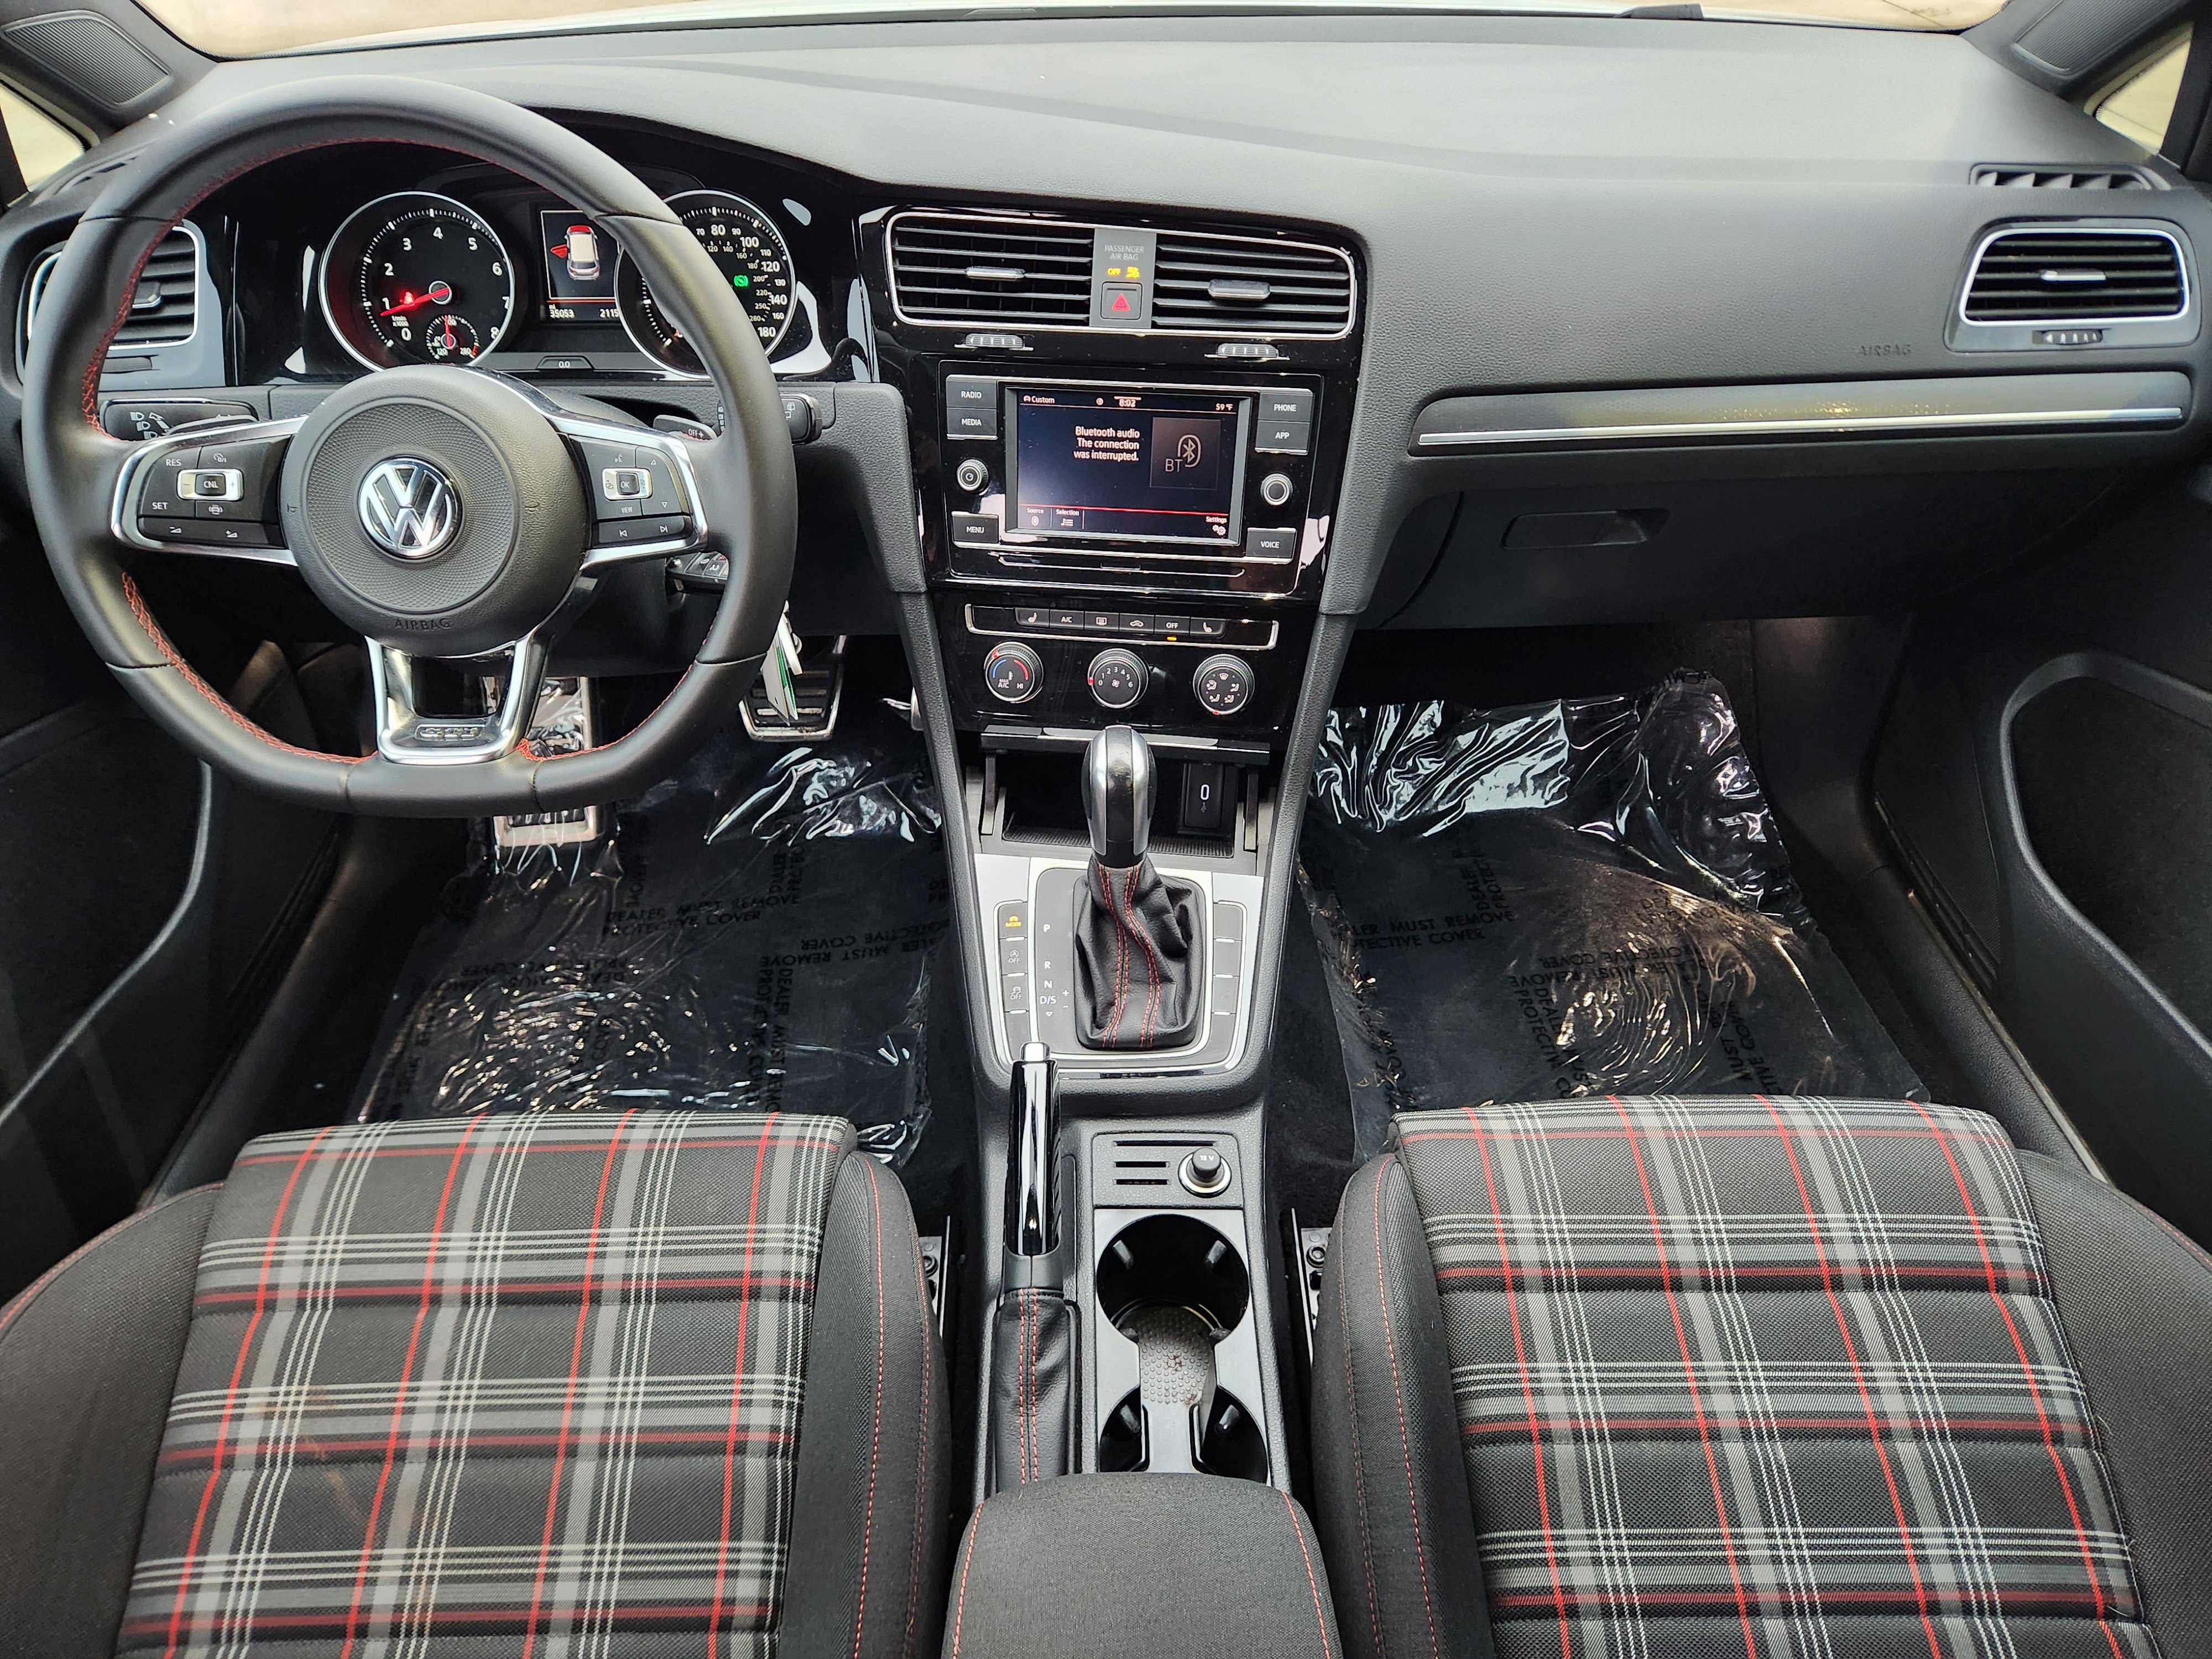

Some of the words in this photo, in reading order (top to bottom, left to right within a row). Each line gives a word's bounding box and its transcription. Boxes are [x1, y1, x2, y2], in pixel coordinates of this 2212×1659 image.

[433, 227, 443, 239] 4
[696, 228, 705, 236] 70
[711, 224, 726, 236] 80
[403, 238, 411, 250] 3
[468, 237, 478, 250] 5
[739, 236, 759, 248] 100
[1105, 244, 1144, 253] PASSENGER
[384, 263, 394, 276] 2
[492, 262, 502, 275] 6
[763, 261, 780, 272] 120
[382, 298, 390, 310] 1
[769, 294, 787, 305] 140
[550, 309, 575, 319] 35053
[401, 327, 412, 341] 0
[491, 327, 499, 339] 8
[758, 327, 776, 337] 180
[961, 390, 982, 399] RADIO
[1031, 395, 1055, 404] Custom
[1119, 399, 1136, 408] 8:02
[1274, 404, 1297, 412] PHONE
[961, 418, 982, 426] MEDIA
[1075, 425, 1115, 438] Bluetooth
[1117, 428, 1140, 439] audio
[1077, 437, 1092, 448] The
[1094, 440, 1140, 450] connection
[1073, 450, 1090, 459] was
[1091, 449, 1139, 462] interrupted.
[1165, 458, 1183, 472] BT
[204, 481, 219, 489] CNL
[1206, 516, 1227, 524] Settings
[394, 618, 451, 630] AIRBAG
[705, 910, 761, 925] COVER
[1389, 918, 1436, 932] MUST
[1445, 910, 1518, 928] REMOVE
[1043, 924, 1051, 932] P
[1428, 928, 1486, 944] COVER
[801, 935, 857, 951] COVER
[759, 951, 831, 967] REMOVE
[842, 945, 890, 961] MUST
[1044, 961, 1051, 969] R
[1538, 953, 1596, 968] COVER
[1044, 980, 1052, 988] N
[1040, 995, 1057, 1005] D/S
